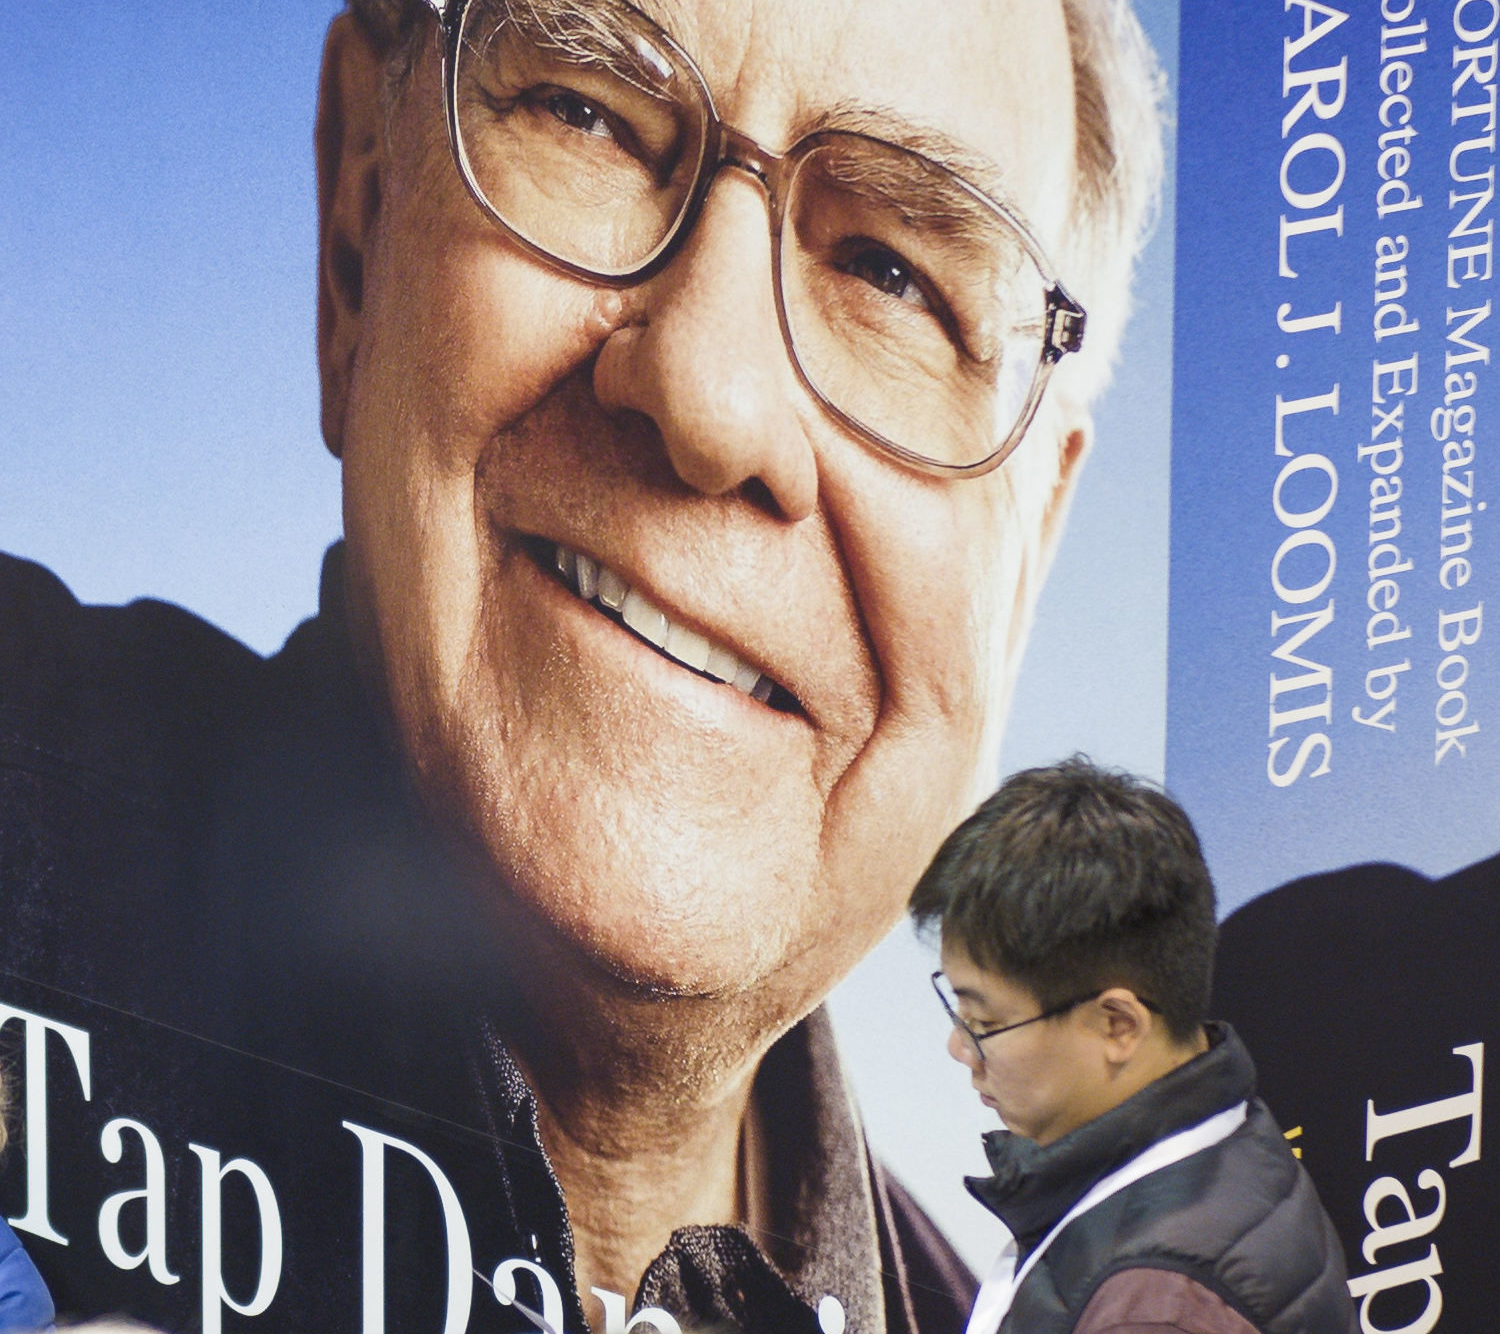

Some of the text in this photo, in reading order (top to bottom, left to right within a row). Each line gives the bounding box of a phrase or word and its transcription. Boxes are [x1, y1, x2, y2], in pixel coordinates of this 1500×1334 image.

[1275, 300, 1343, 369] J.
[1372, 234, 1421, 343] and
[1356, 352, 1420, 651] Expanded
[1430, 299, 1492, 591] Magazine
[1266, 383, 1341, 788] LOOMIS
[1351, 658, 1413, 734] by
[1434, 601, 1483, 765] Book
